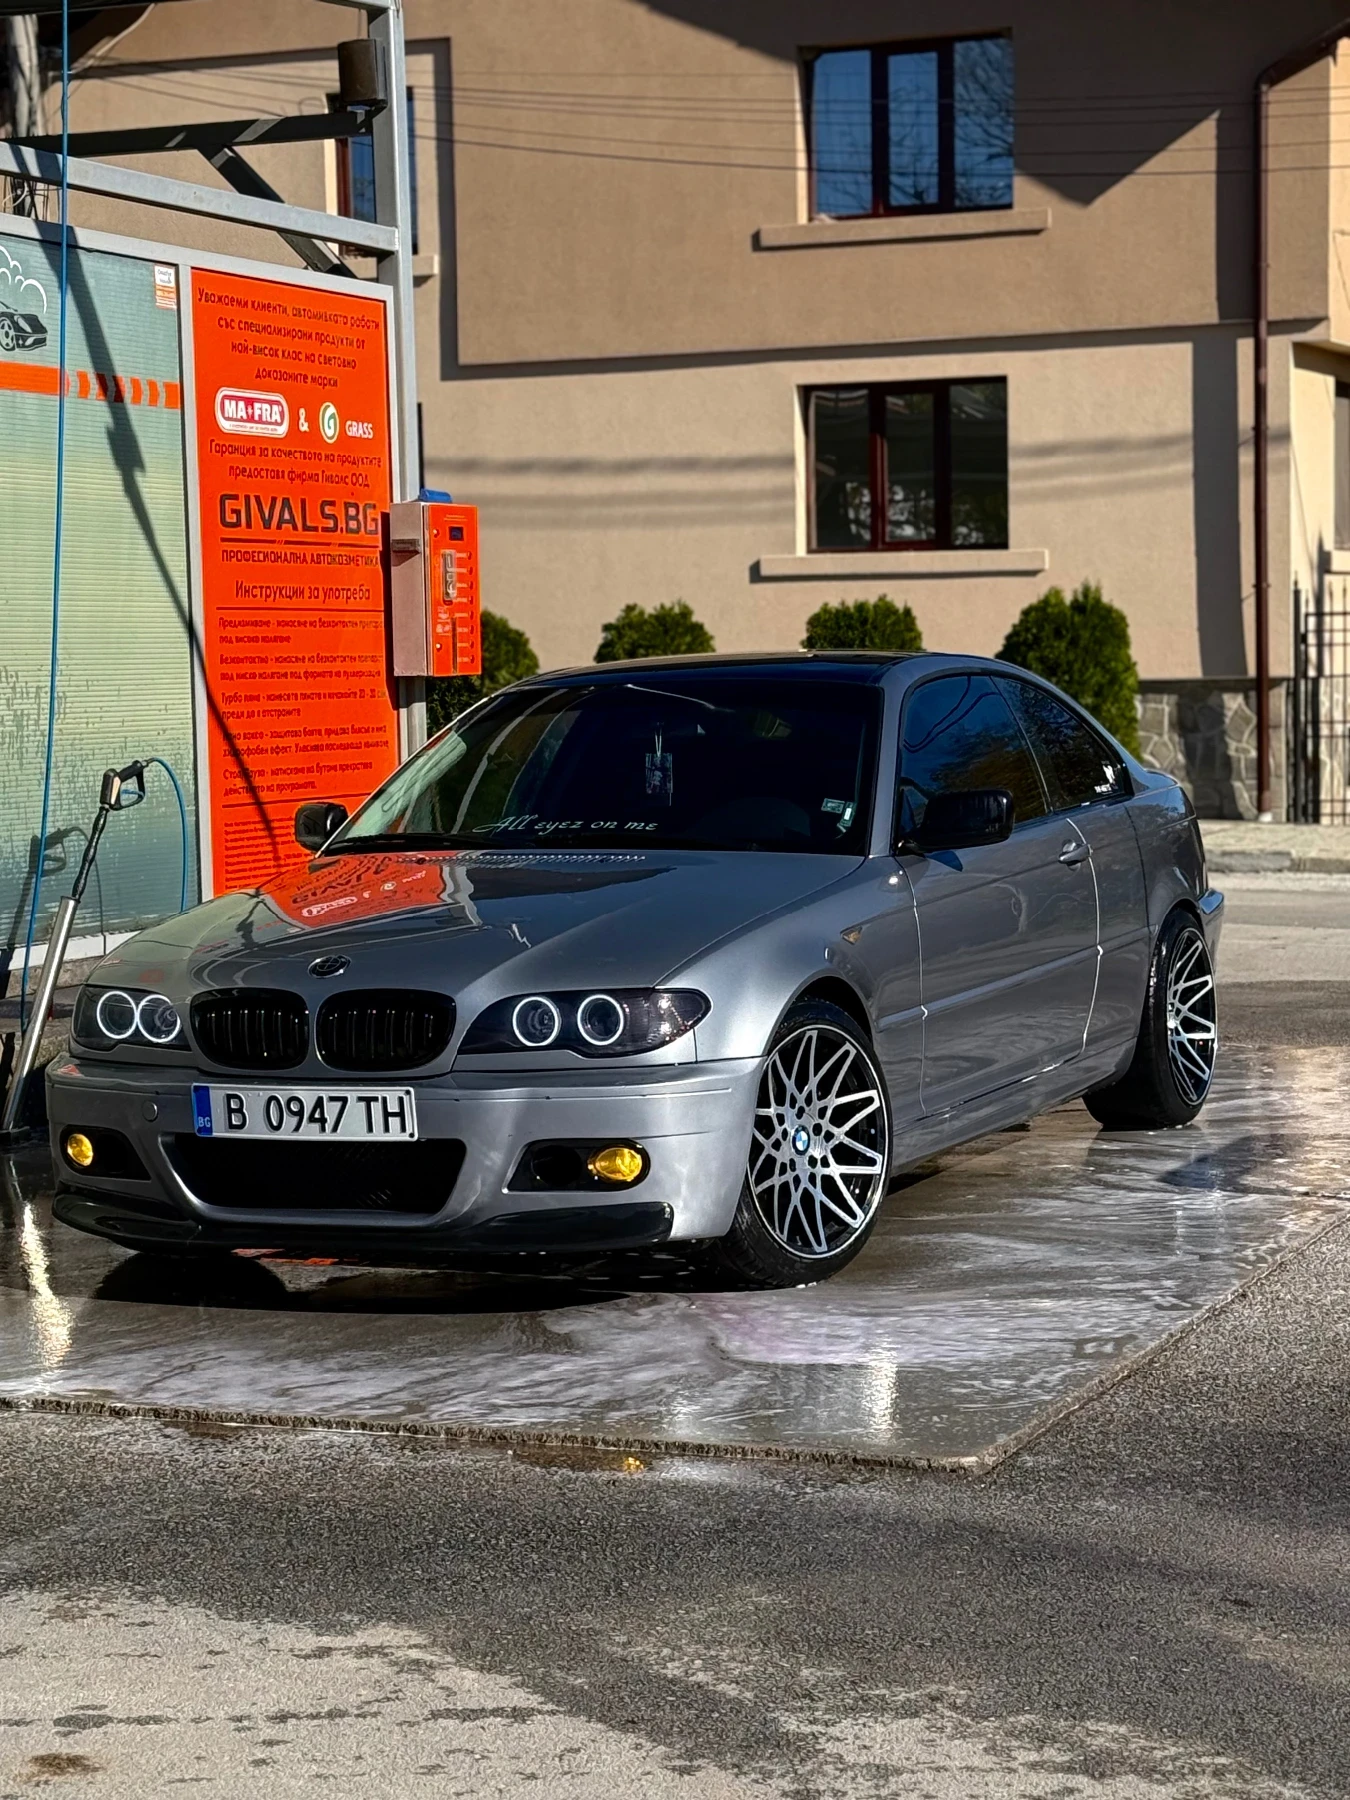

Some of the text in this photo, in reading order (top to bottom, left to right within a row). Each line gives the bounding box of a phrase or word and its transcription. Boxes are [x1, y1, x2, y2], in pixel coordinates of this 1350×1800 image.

[198, 287, 249, 309] Уважаеми
[251, 300, 290, 317] клиенти,
[292, 306, 348, 326] автомивката
[217, 316, 365, 349] със специализирани продукти от
[231, 339, 357, 370] най-висок клас на световно
[255, 367, 338, 390] доказаните марки
[299, 407, 309, 432] &
[345, 420, 373, 439] GRASS
[209, 439, 382, 468] Гаранция за качеството на продуктите
[229, 465, 285, 480] предоставя
[288, 467, 320, 484] фирма
[350, 472, 370, 488] ООД
[220, 493, 379, 535] GIVALS.BG
[221, 550, 379, 567] ПРОФЕСИОНАЛНА АВТОКОЗМЕТИКА
[235, 580, 370, 604] Инструкции за употреба
[472, 814, 658, 835] All eyez on me
[198, 1117, 211, 1128] BG
[225, 1093, 407, 1134] B 0947 TH
